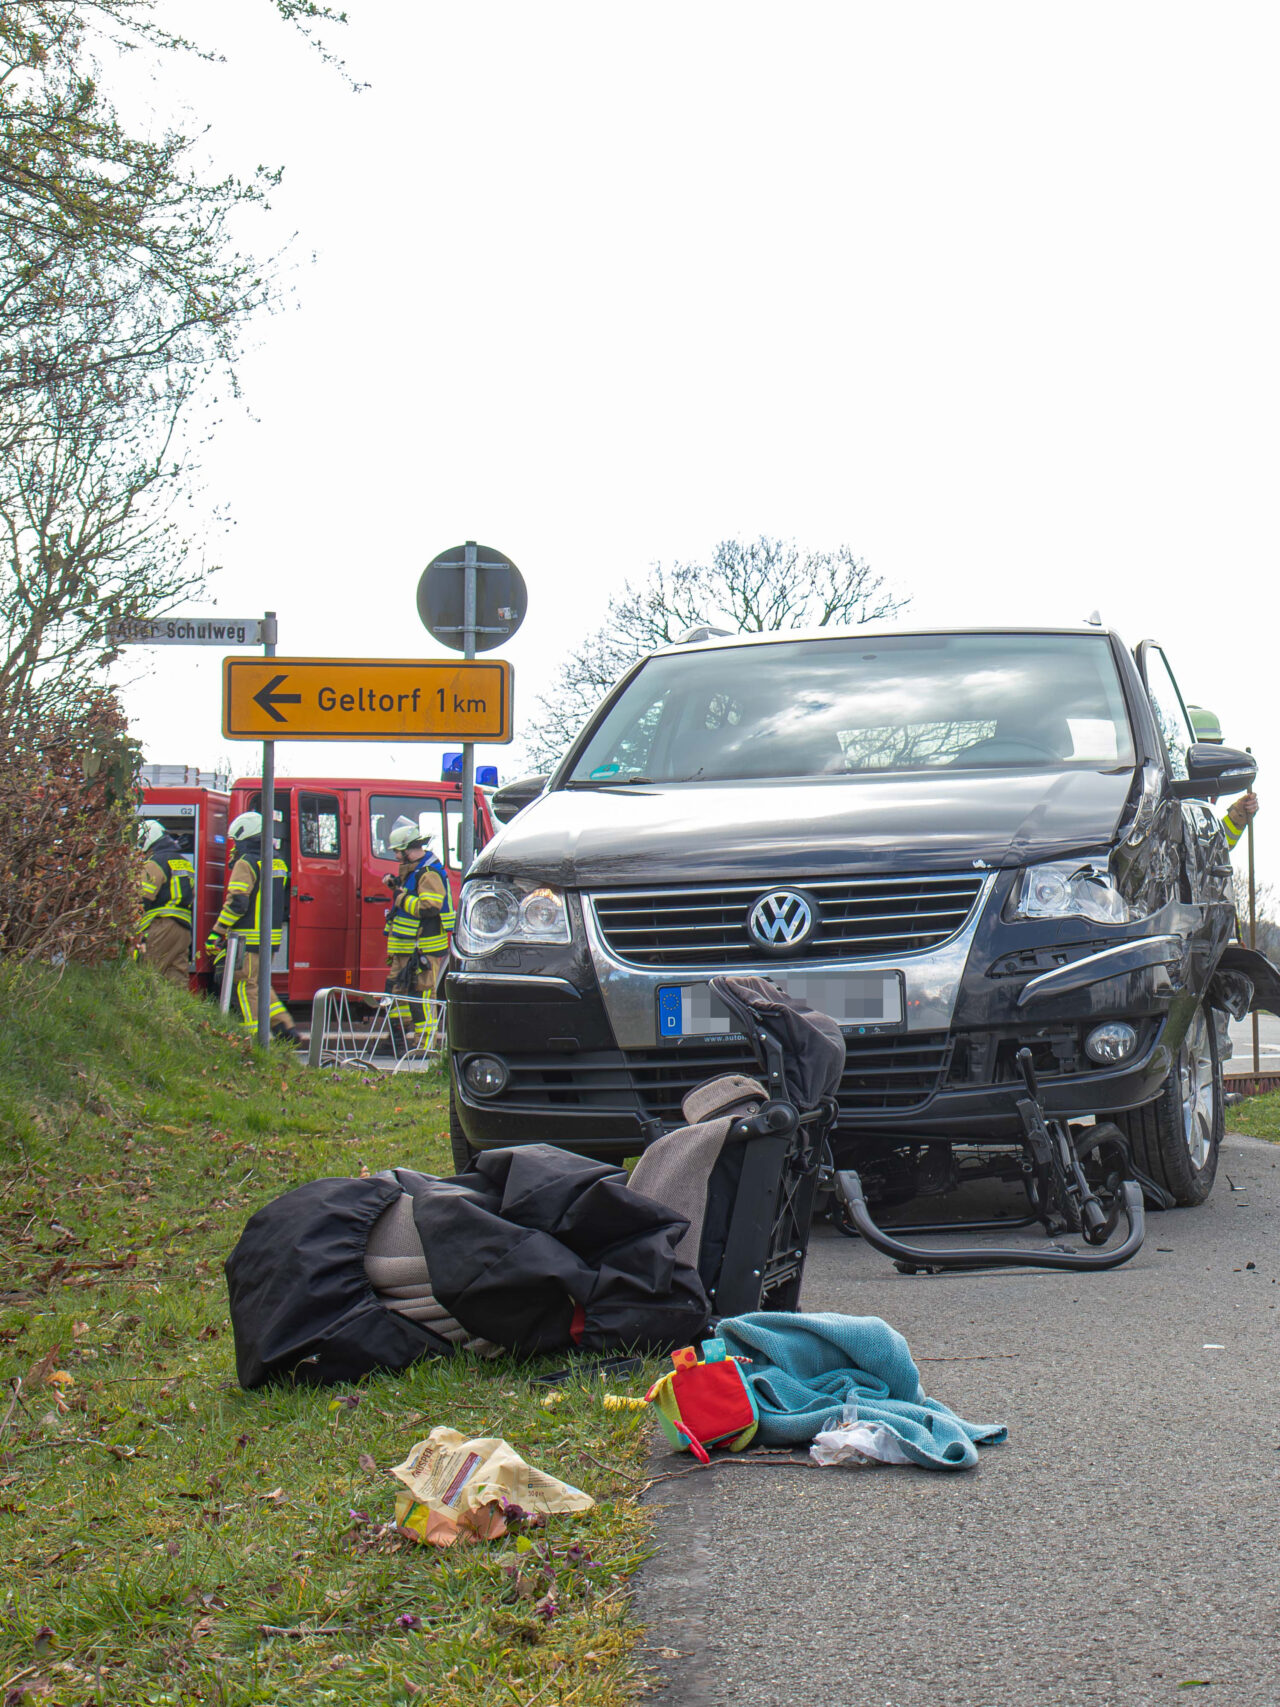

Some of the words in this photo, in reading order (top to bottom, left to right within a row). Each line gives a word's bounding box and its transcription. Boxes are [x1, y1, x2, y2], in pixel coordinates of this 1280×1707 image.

[166, 621, 246, 643] Schulweg
[317, 686, 421, 713] Geltorf
[436, 688, 445, 713] 1
[453, 694, 487, 713] km
[180, 807, 193, 816] G2
[750, 891, 812, 947] VW
[667, 1016, 676, 1028] D
